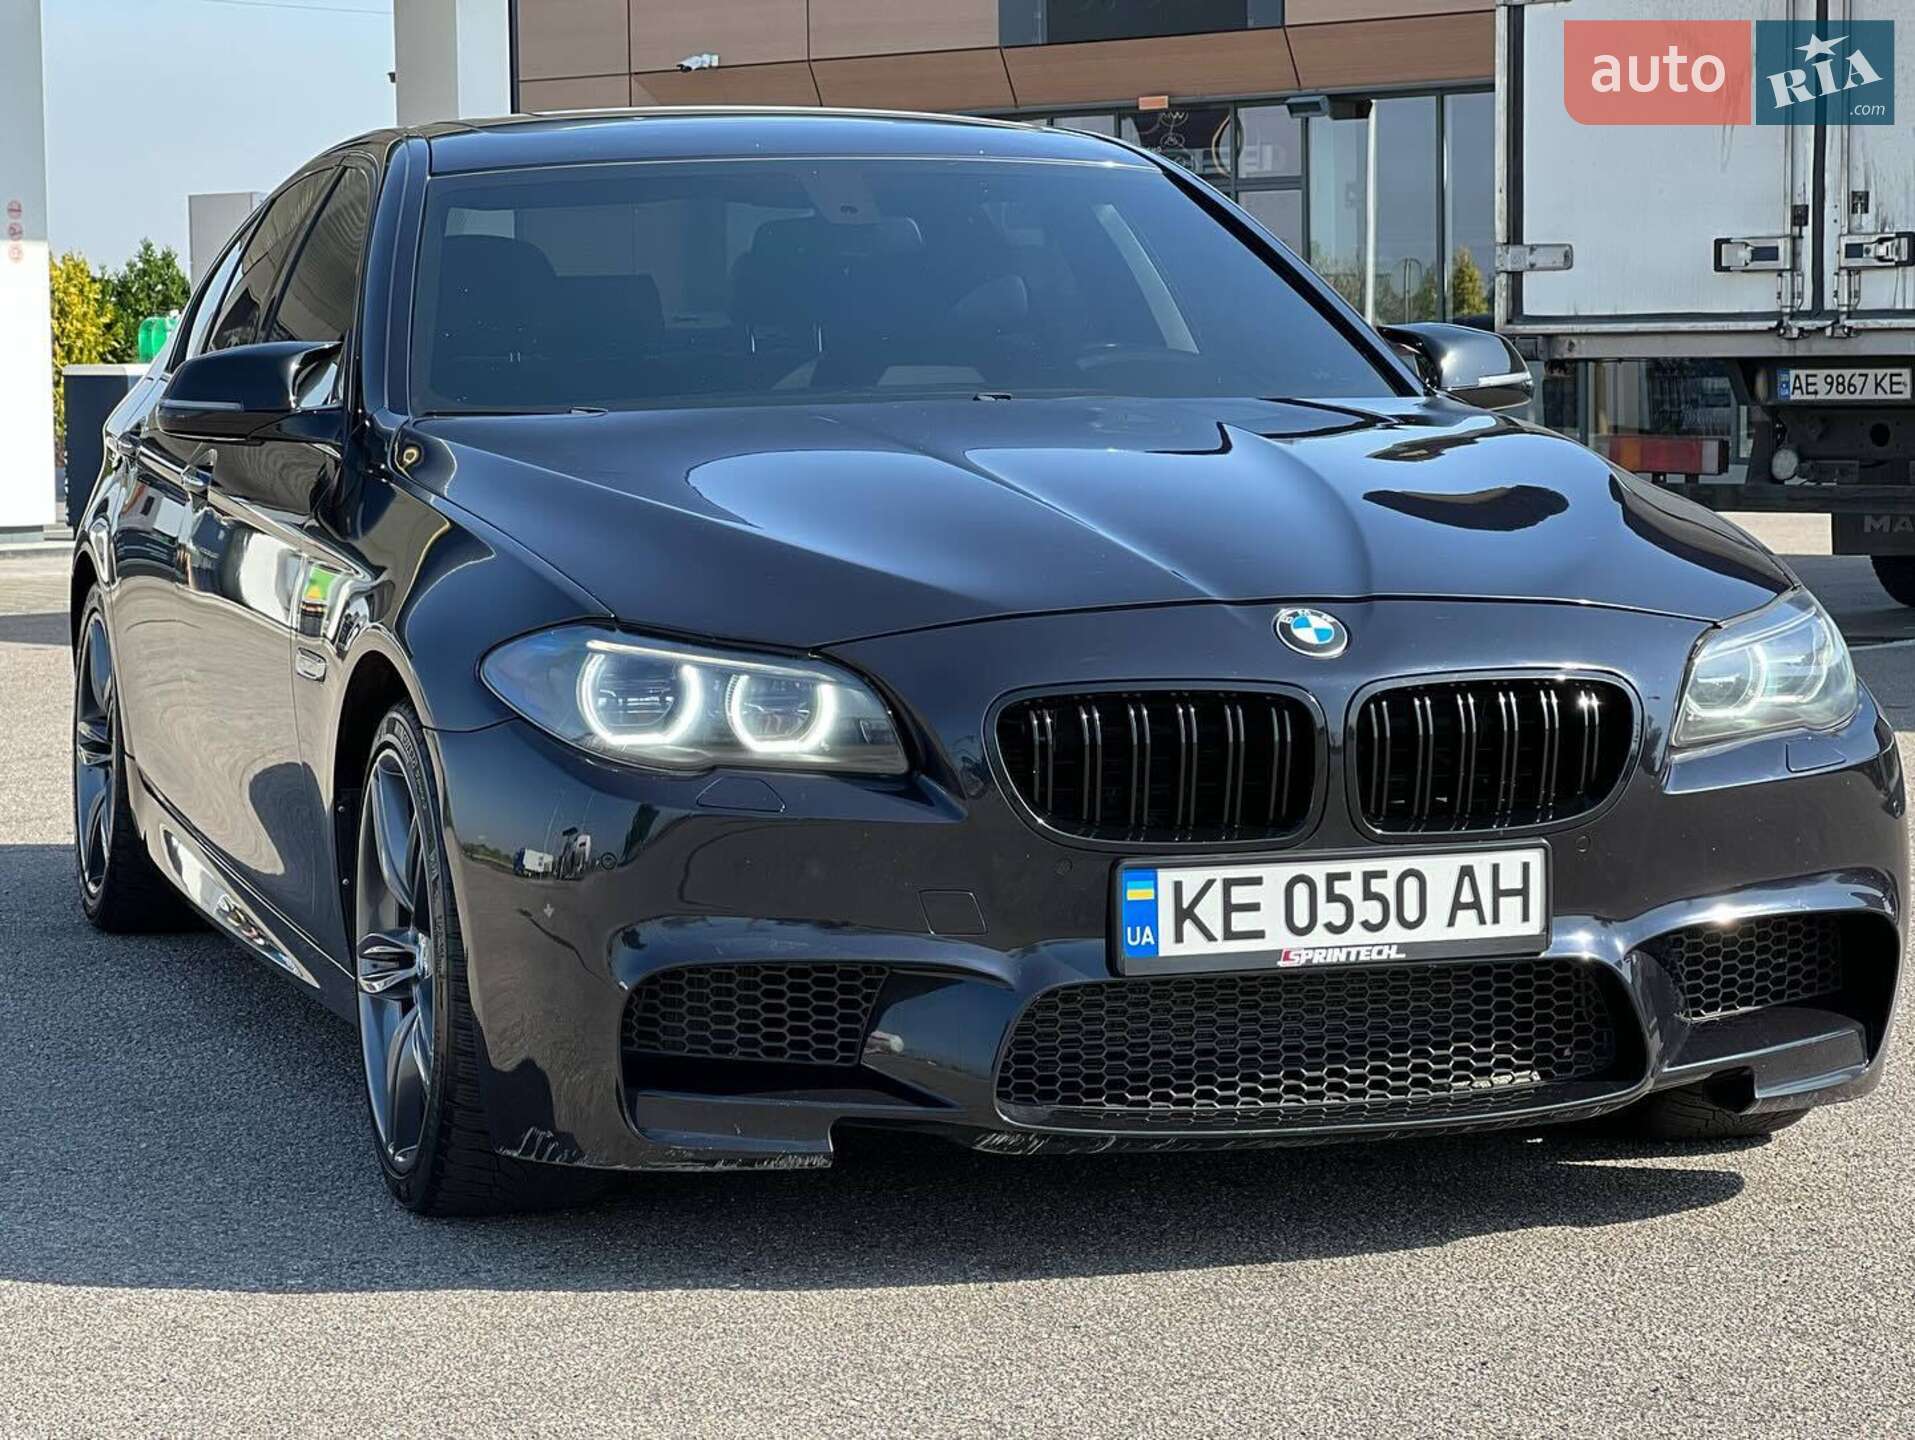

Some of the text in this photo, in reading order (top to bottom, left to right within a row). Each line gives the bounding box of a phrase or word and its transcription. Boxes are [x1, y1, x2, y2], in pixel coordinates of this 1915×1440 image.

[1791, 373, 1903, 396] AE 9867 KE
[1173, 861, 1531, 945] KE 0550 AH
[1127, 926, 1155, 946] UA
[1277, 945, 1406, 967] SPRINTECH
